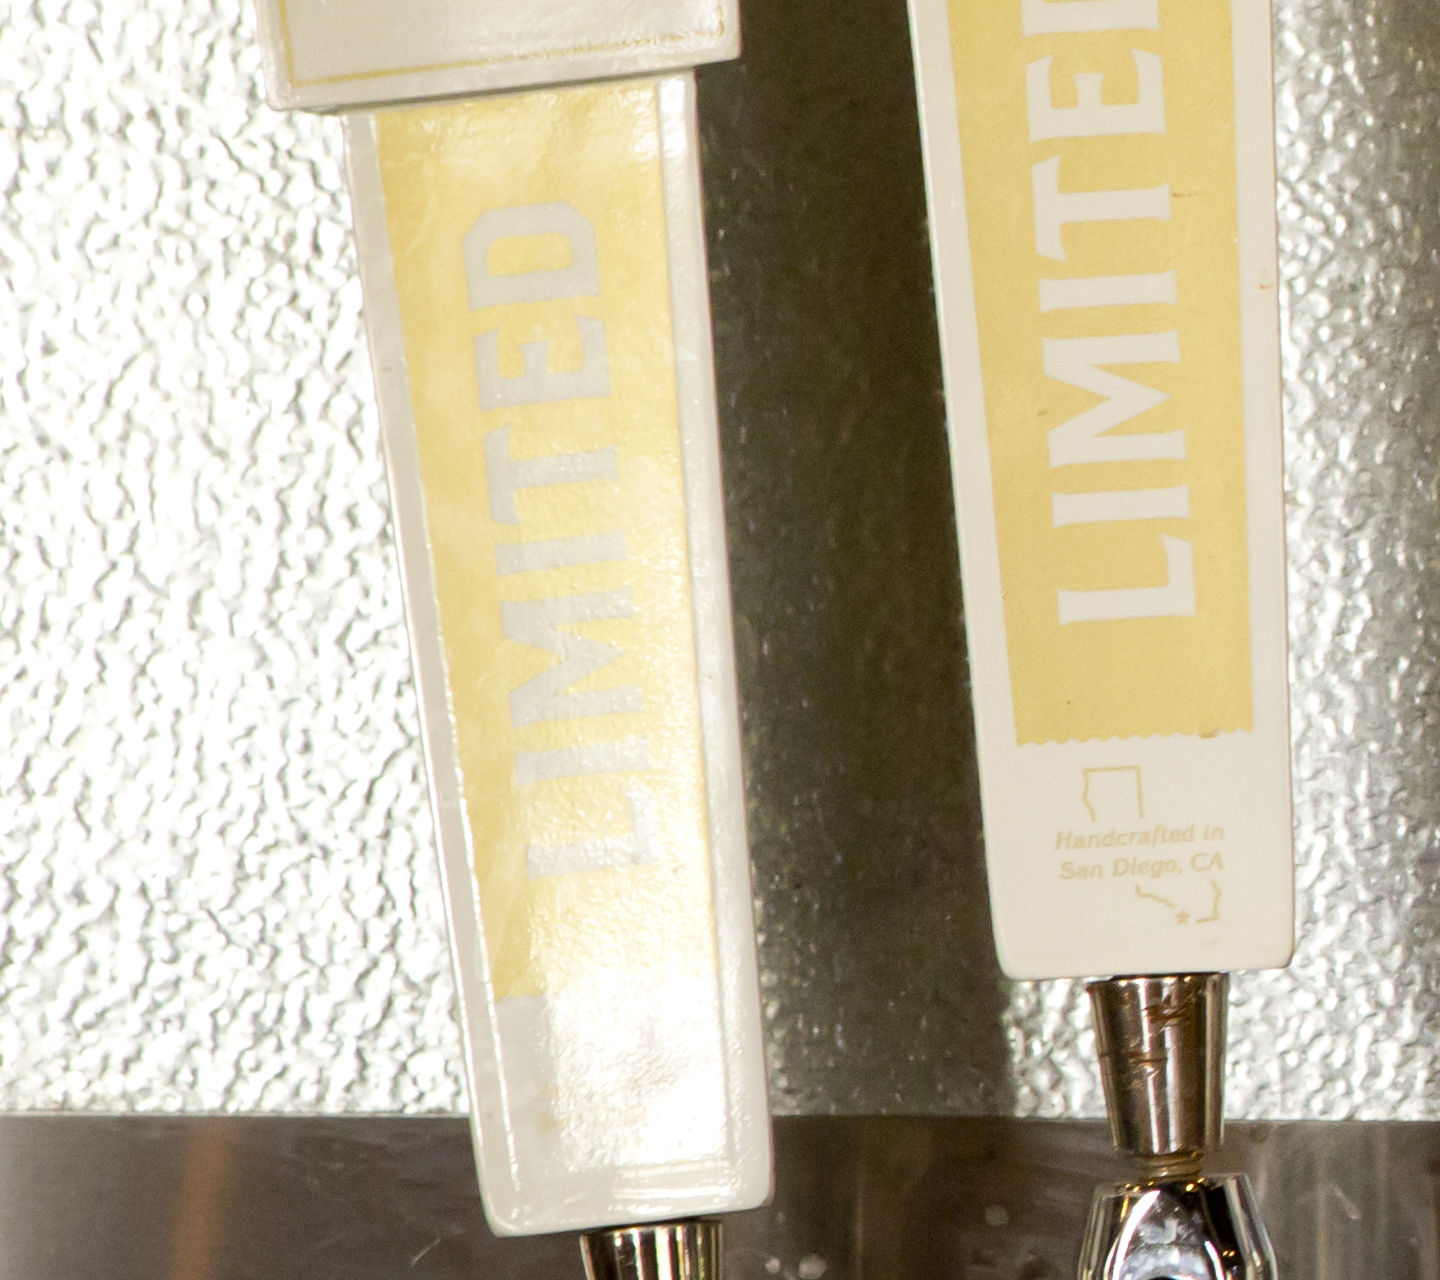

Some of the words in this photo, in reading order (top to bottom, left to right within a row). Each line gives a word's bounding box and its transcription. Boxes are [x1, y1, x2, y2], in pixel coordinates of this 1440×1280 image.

[463, 199, 659, 882] LIMITED
[1055, 824, 1194, 850] Handcrafted
[1203, 825, 1225, 841] in
[1060, 861, 1104, 880] San
[1113, 858, 1183, 879] Diego,
[1190, 852, 1223, 871] CA
